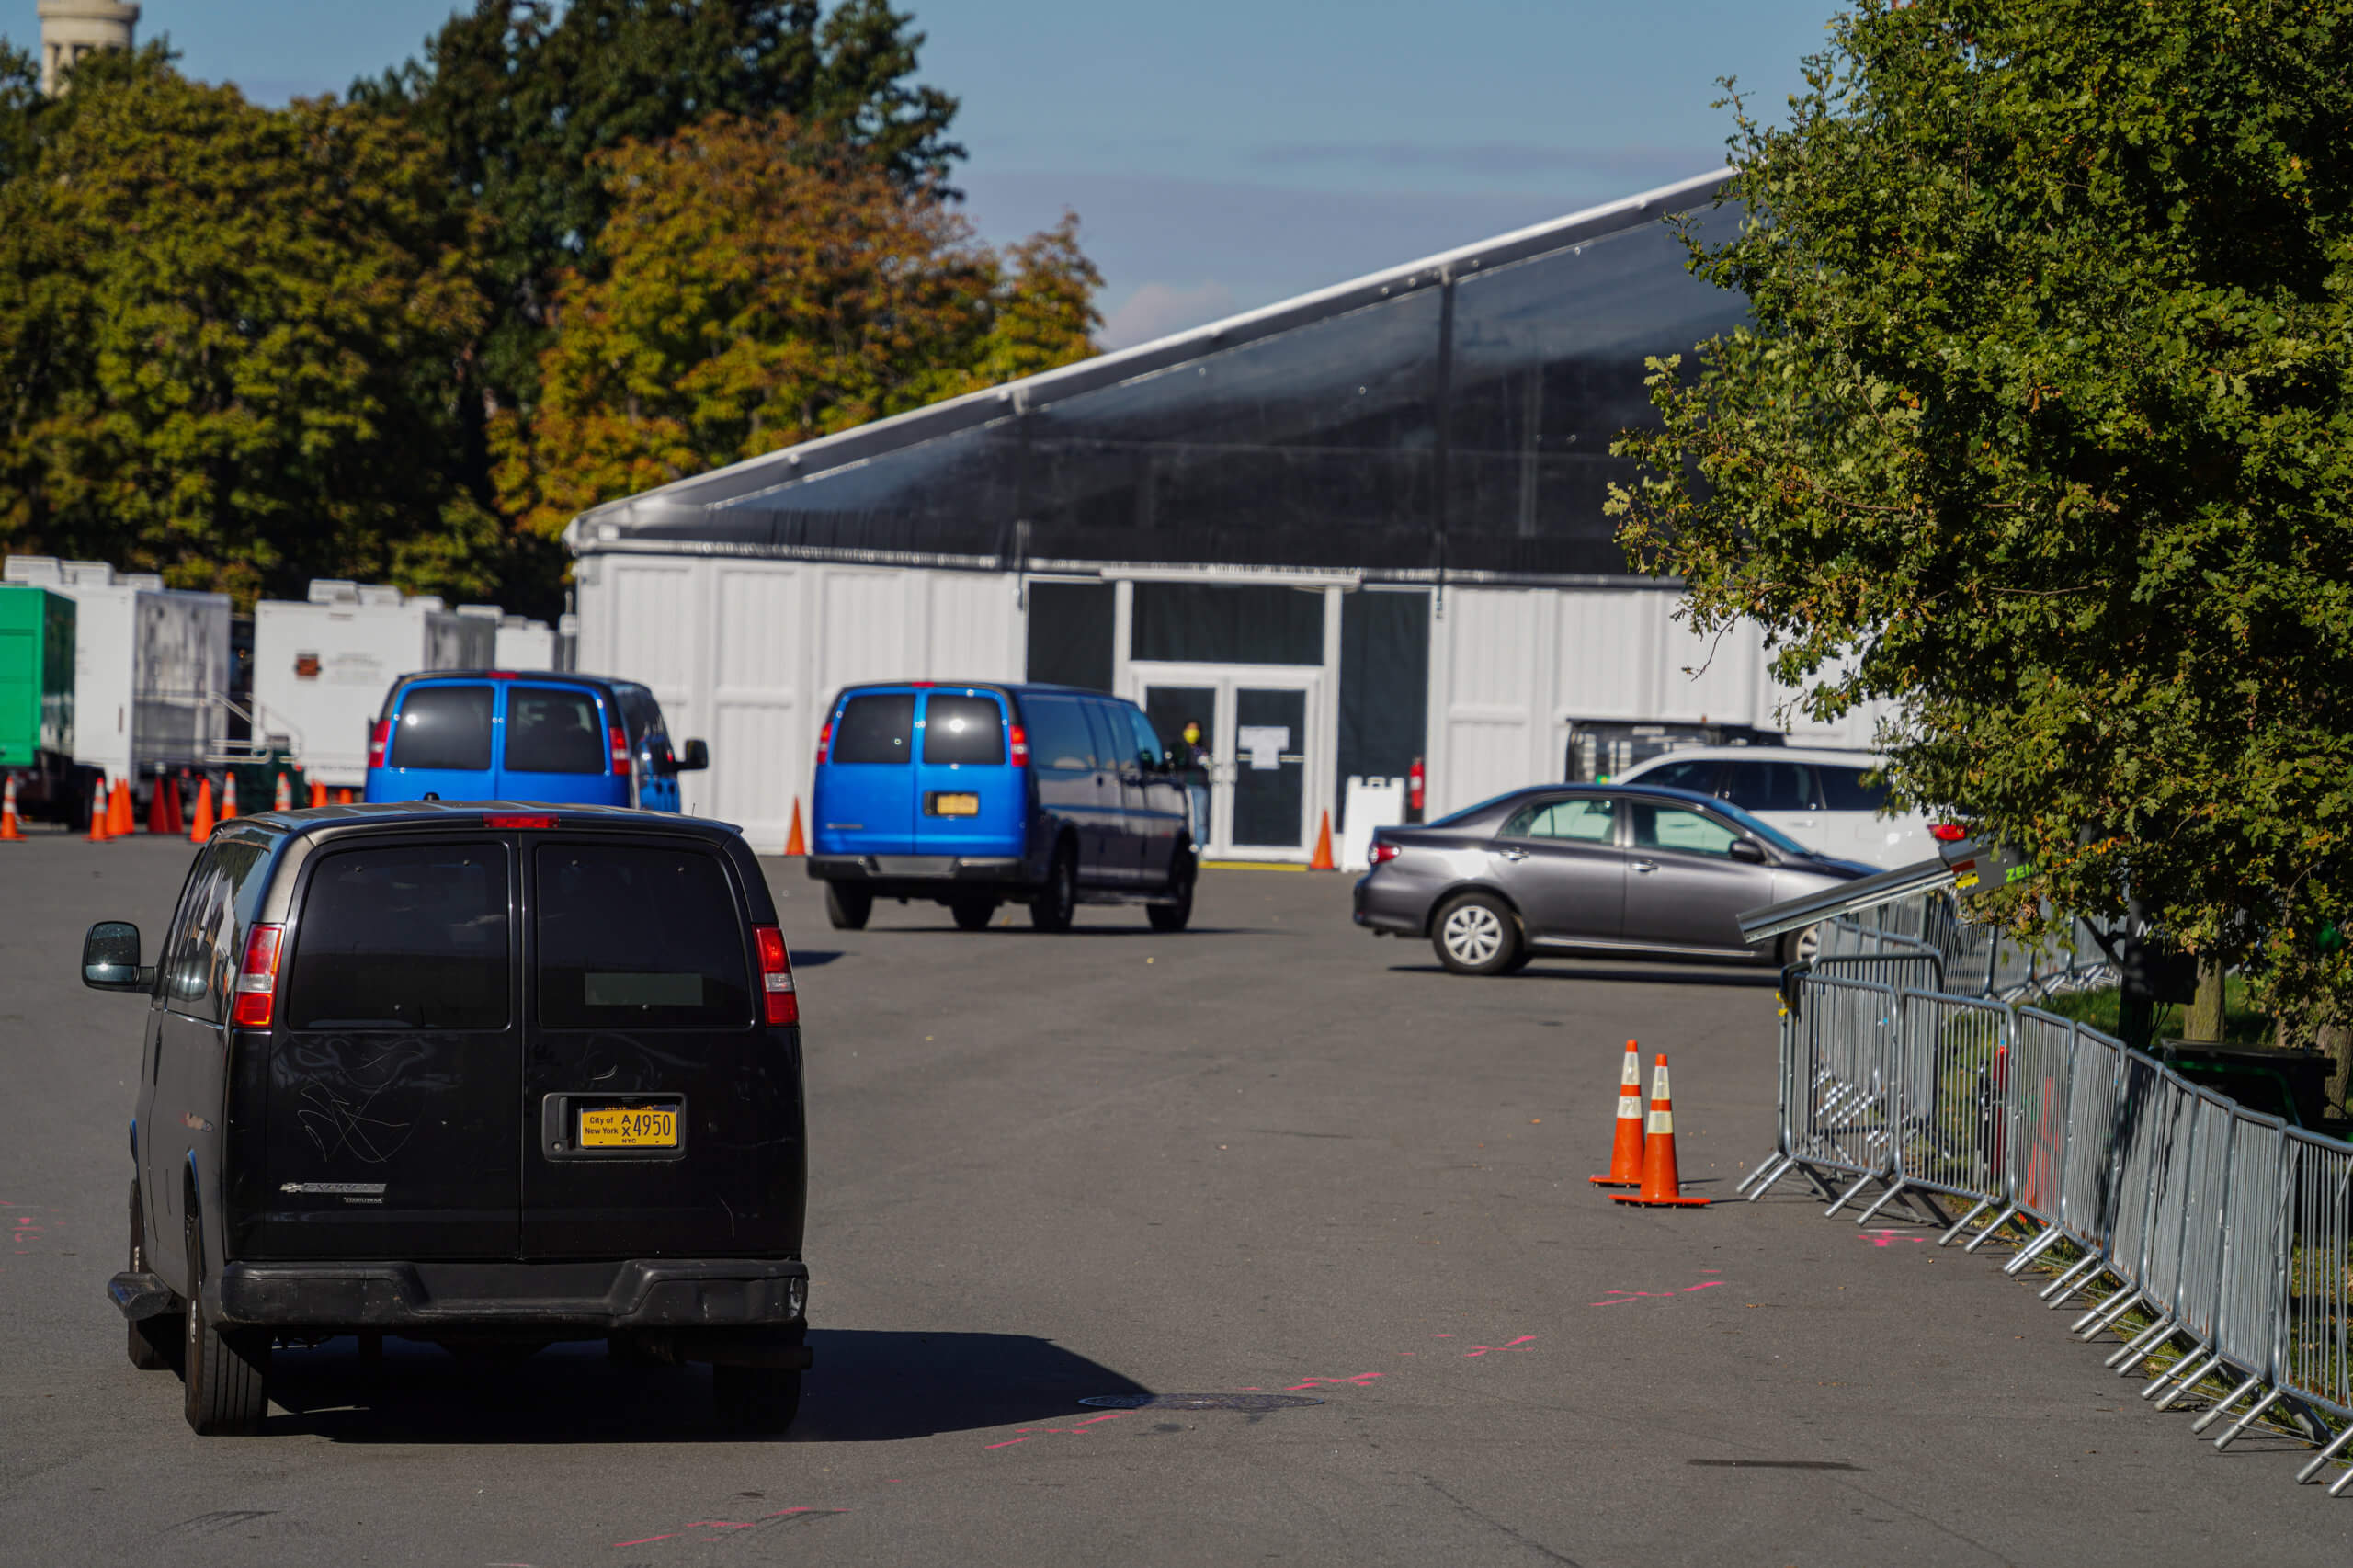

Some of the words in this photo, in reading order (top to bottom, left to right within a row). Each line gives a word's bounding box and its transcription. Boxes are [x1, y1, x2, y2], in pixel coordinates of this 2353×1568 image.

[589, 1116, 604, 1125] City
[606, 1116, 614, 1124] of
[633, 1114, 671, 1137] 4950
[585, 1126, 601, 1135] New
[602, 1126, 619, 1135] York
